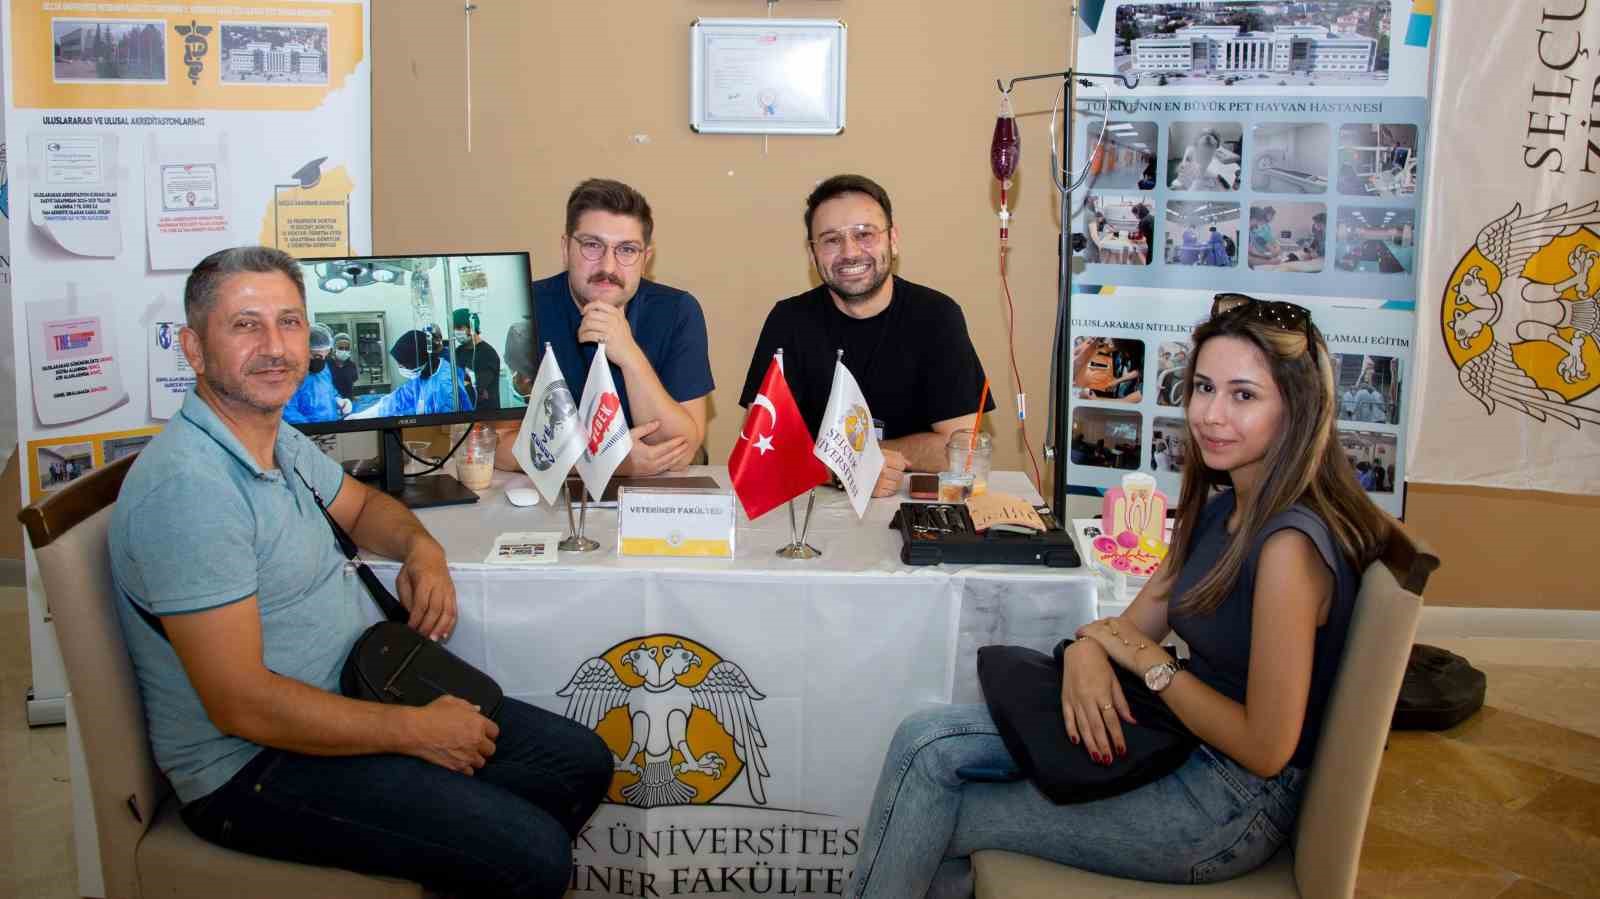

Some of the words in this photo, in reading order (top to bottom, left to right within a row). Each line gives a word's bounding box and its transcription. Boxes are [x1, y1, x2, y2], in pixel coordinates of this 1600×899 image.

[1522, 0, 1589, 174] SELÇU
[1164, 102, 1181, 112] EN
[1229, 102, 1251, 112] PET
[1255, 102, 1307, 113] HAYVAN
[1071, 319, 1144, 330] ULUSLARARASI
[1145, 322, 1193, 334] NİTELİKT
[1323, 333, 1369, 345] LAMALI
[608, 821, 860, 858] ÜNİVERSİTES
[570, 857, 661, 898] İNER
[669, 860, 855, 898] FAKÜLTE
